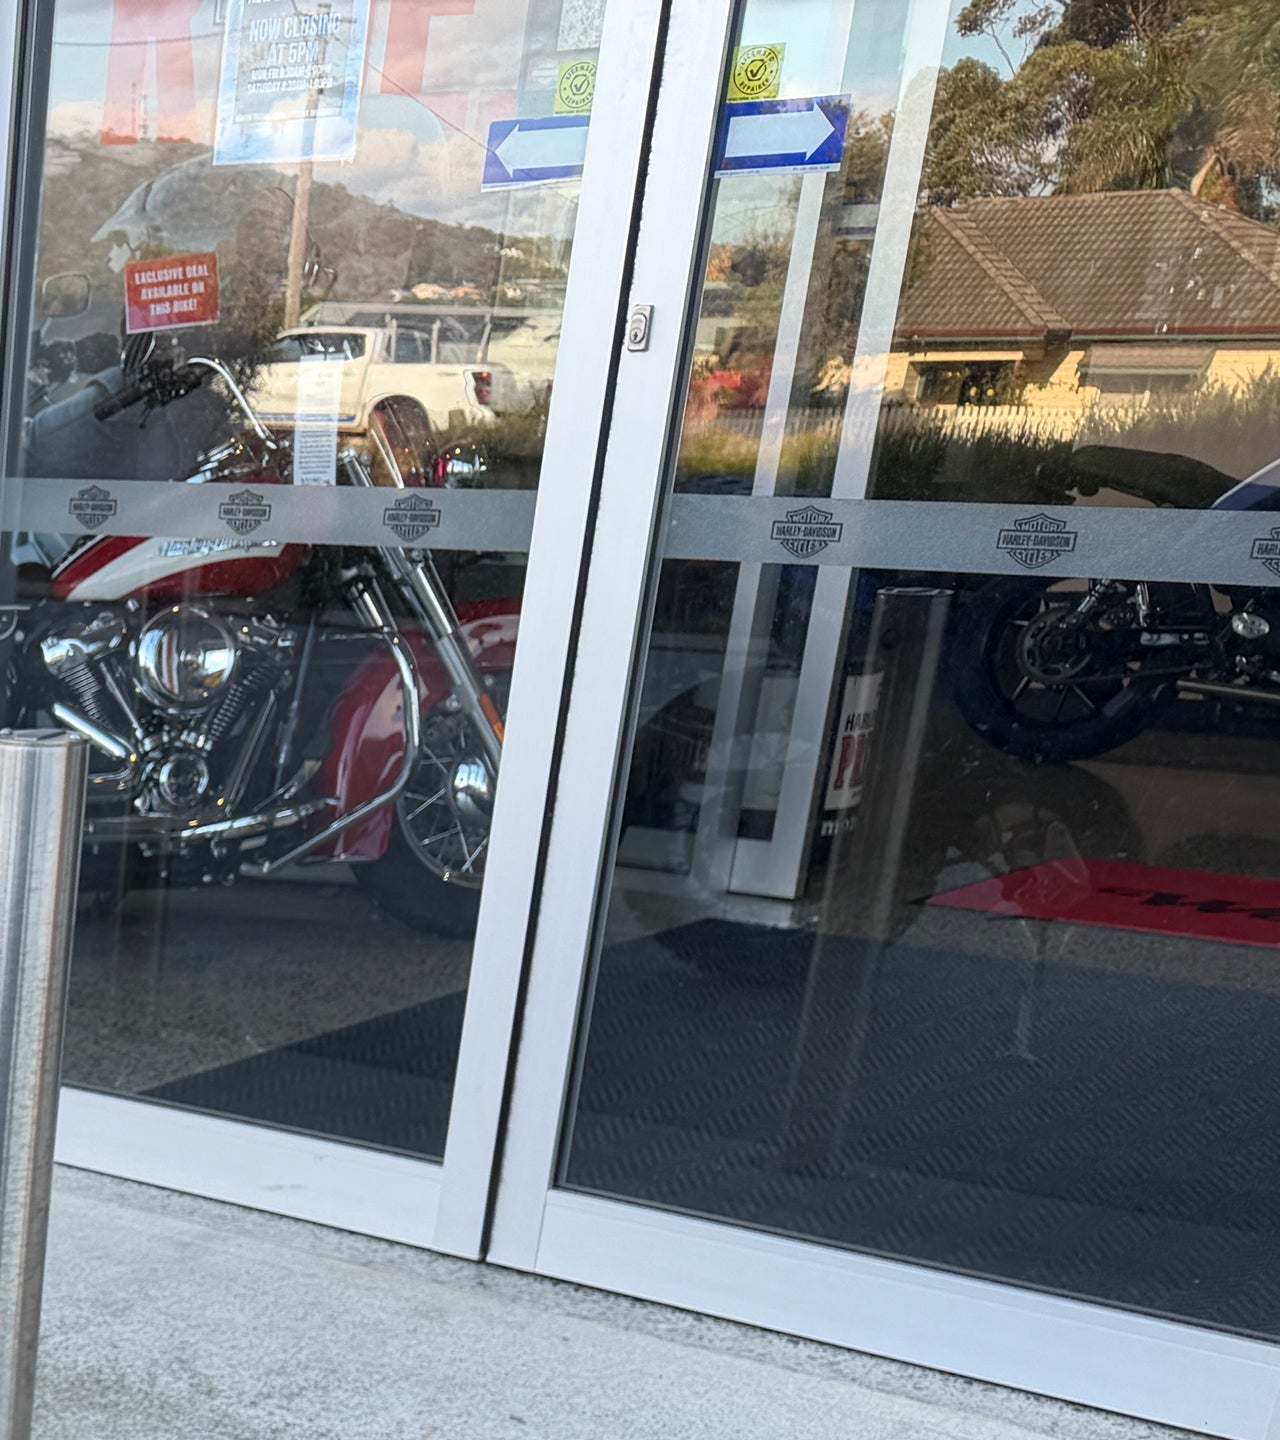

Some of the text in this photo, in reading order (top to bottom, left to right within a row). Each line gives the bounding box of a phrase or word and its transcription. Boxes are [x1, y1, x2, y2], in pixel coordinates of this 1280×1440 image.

[248, 12, 342, 42] NOW CLOSING
[266, 40, 320, 66] AT 5PM
[134, 263, 209, 285] EXCLUSIVE DEAL
[140, 280, 206, 300] AVAILABLE ON
[149, 301, 172, 316] THIS
[775, 524, 838, 539] HARLEY-DAVIDSON
[1021, 520, 1058, 532] MOTOR
[1002, 533, 1071, 548] HARLEY-DAVIDSON
[1256, 542, 1280, 556] HARL
